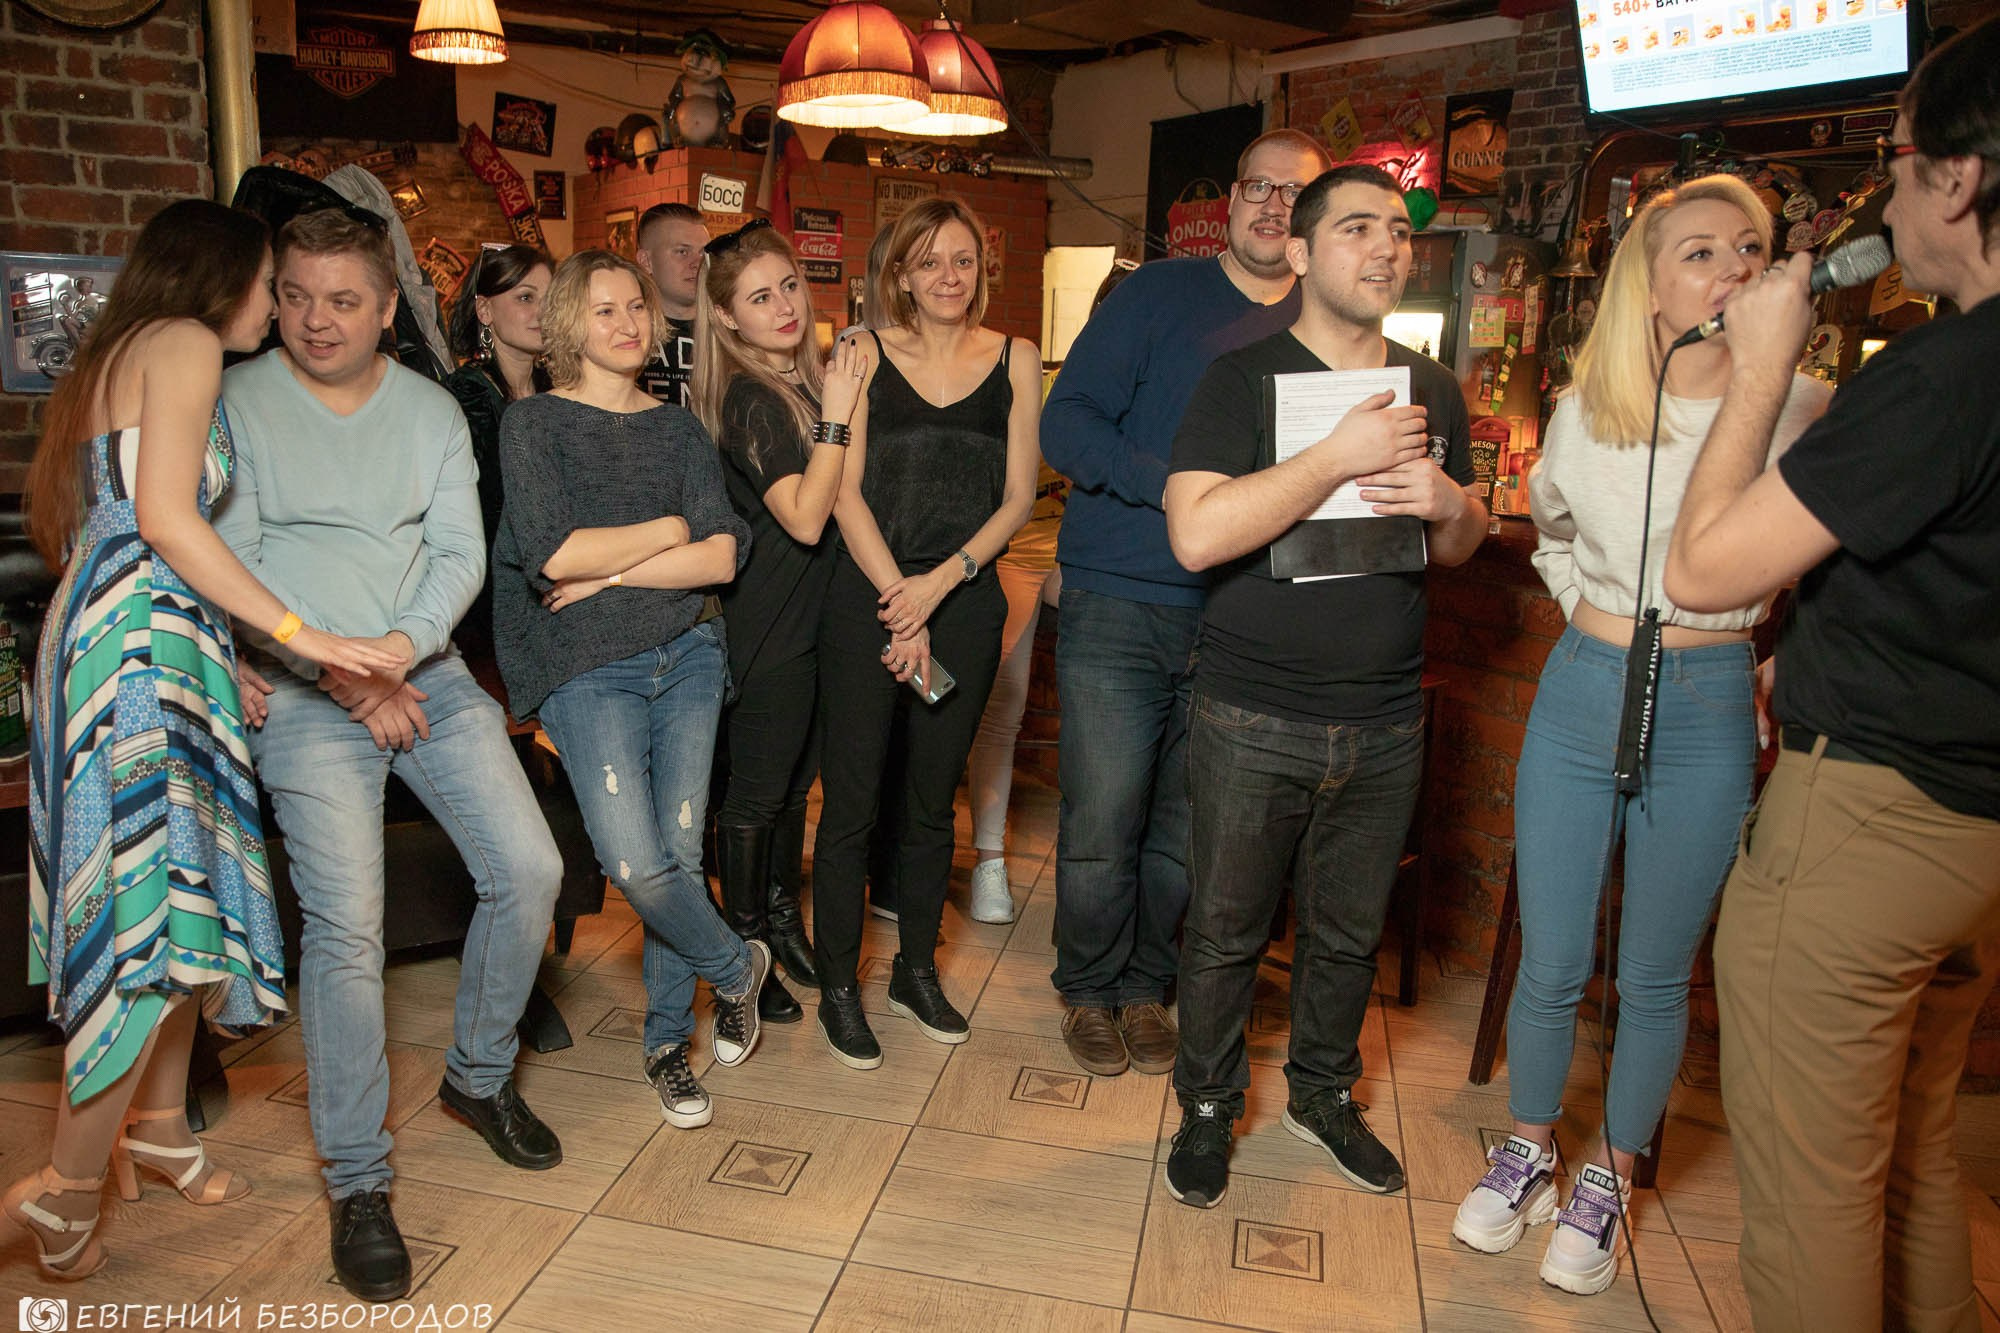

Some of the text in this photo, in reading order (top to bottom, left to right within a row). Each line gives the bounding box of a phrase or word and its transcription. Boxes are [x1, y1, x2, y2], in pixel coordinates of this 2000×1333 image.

[319, 29, 367, 46] MOTOR
[299, 47, 388, 68] HARLEY-DAVIDSON
[321, 69, 370, 92] CYCLES
[1453, 149, 1504, 168] GUINNE
[703, 184, 742, 207] БОСС
[879, 183, 890, 198] NO
